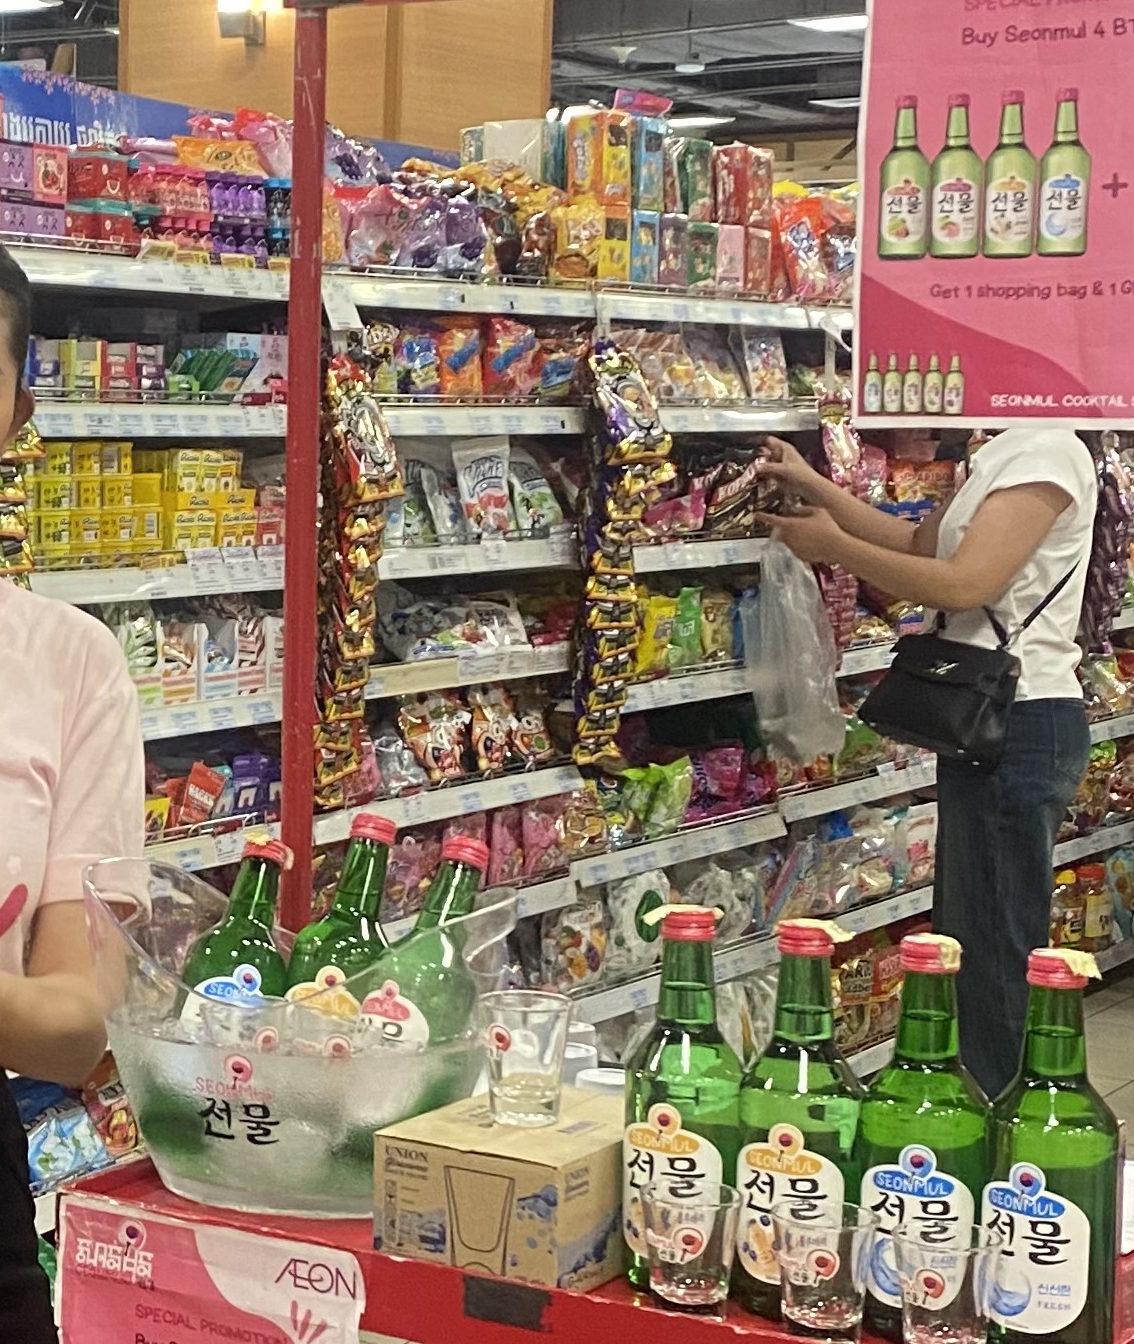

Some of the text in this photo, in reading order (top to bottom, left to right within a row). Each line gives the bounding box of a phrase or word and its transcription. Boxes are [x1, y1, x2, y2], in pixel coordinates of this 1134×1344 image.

[962, 27, 999, 48] Buy
[1005, 20, 1087, 43] Seonmul
[1093, 21, 1105, 38] 4
[930, 283, 960, 299] Get
[977, 282, 1052, 300] shopping
[1057, 282, 1088, 299] bag
[1092, 281, 1104, 296] &
[1121, 279, 1134, 296] G
[990, 394, 1059, 407] SEONMUL
[198, 1096, 281, 1146] 선물
[630, 1129, 694, 1153] SEONMUL
[749, 1149, 817, 1174] SEONMUL
[875, 1172, 950, 1196] SEONMUL
[991, 1188, 1060, 1217] SEONMUL
[135, 1304, 196, 1331] SPECIAL
